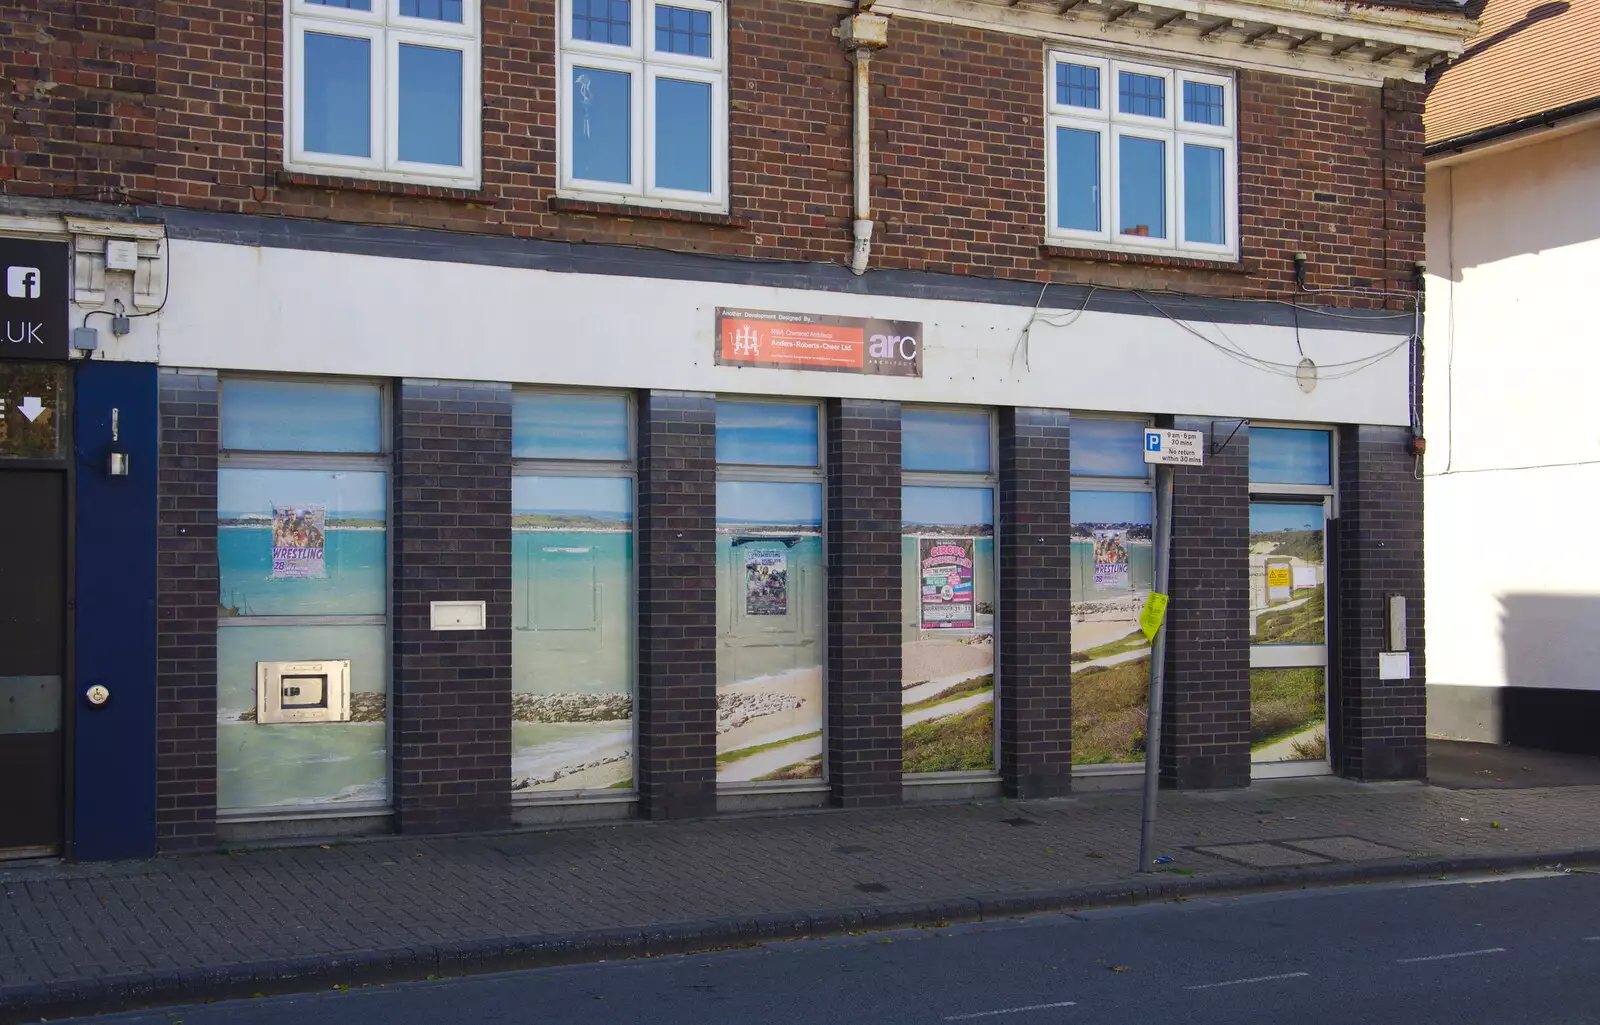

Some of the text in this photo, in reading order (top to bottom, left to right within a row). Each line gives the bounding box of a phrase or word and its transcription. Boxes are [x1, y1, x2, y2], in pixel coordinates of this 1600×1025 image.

[744, 311, 776, 320] Development
[778, 314, 802, 322] Designed
[869, 334, 916, 360] arc
[1149, 435, 1159, 450] P
[273, 548, 322, 560] WRESTLING
[931, 545, 966, 557] CIRCUS
[1095, 564, 1128, 573] WRESTLING
